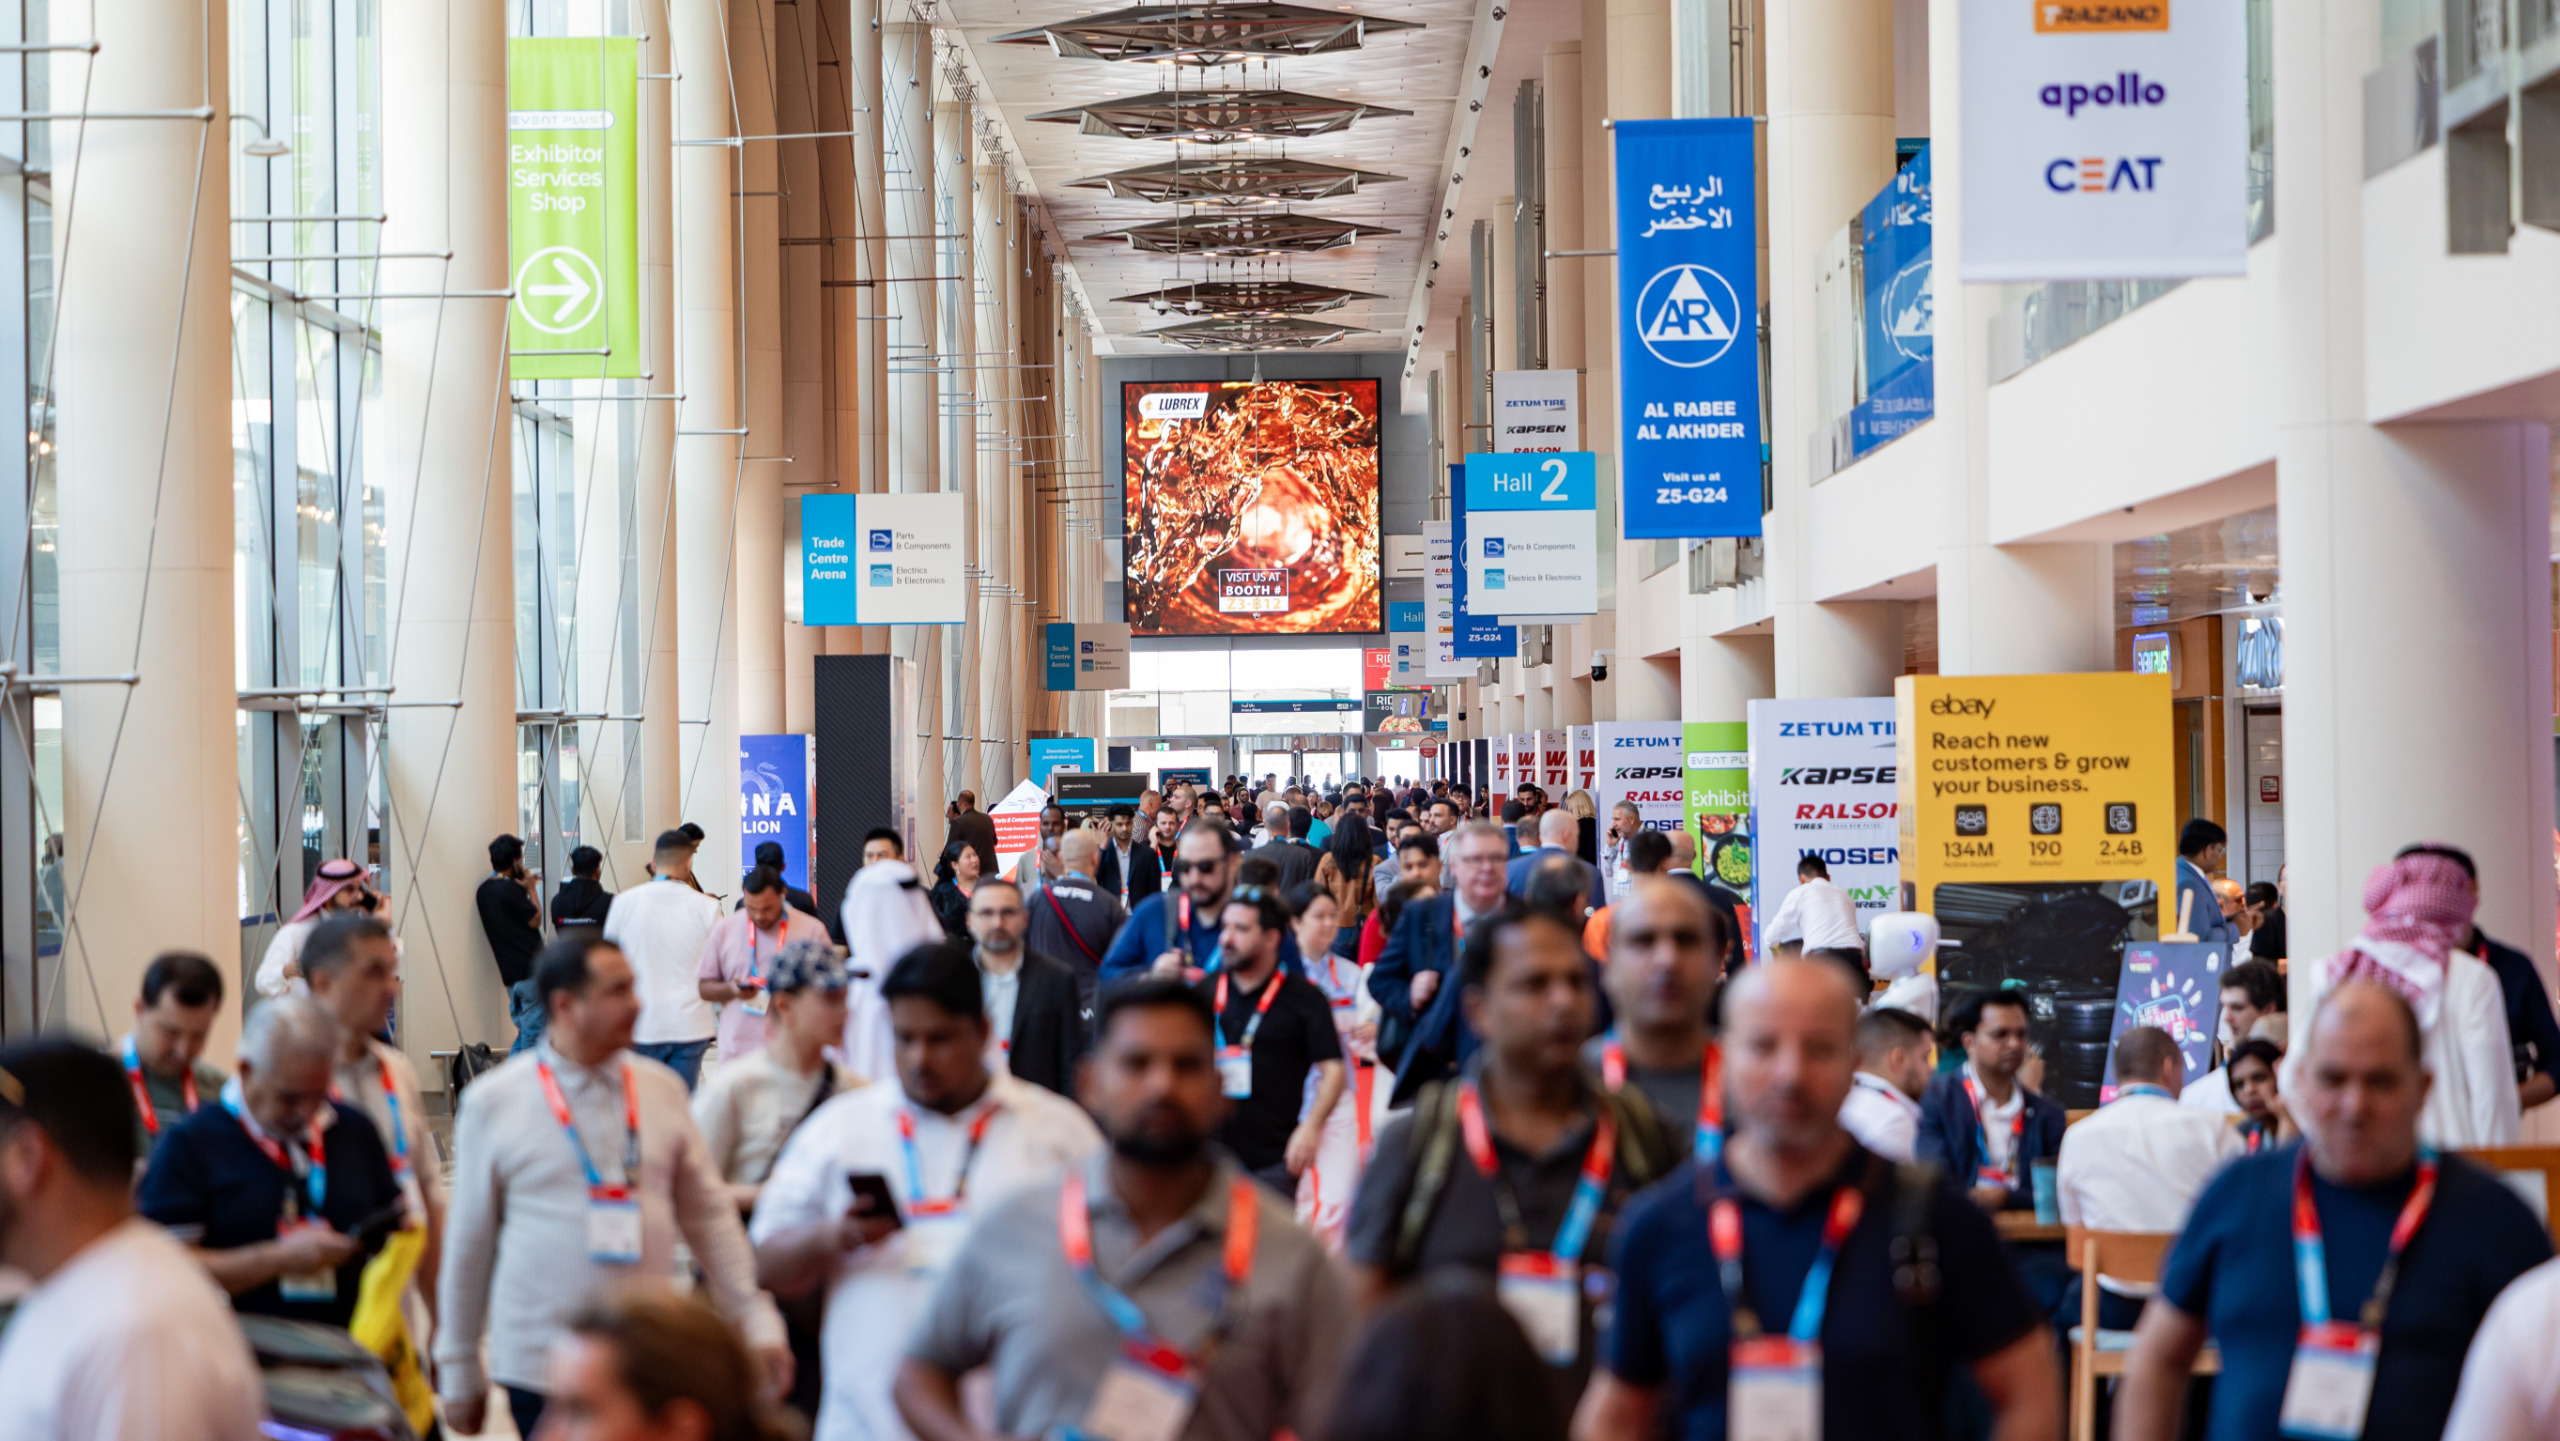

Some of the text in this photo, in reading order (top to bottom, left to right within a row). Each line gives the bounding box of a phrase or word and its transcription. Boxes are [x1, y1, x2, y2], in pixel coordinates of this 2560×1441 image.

[2042, 5, 2159, 25] TRAZANO
[2039, 72, 2165, 117] apollo
[511, 144, 604, 162] Exhibitor
[514, 168, 602, 187] Services
[2045, 158, 2162, 192] CEAT
[1649, 175, 1723, 210] الربيع
[531, 192, 586, 215] Shop
[1658, 298, 1713, 336] AR
[1159, 398, 1200, 410] LUBREX
[1644, 400, 1736, 418] AL RABEE
[1637, 422, 1745, 440] AL AKHDER
[1493, 458, 1568, 502] Hall 2
[1663, 471, 1721, 482] Visit us at
[1656, 487, 1728, 504] Z5-G24
[812, 537, 844, 548] Trade
[896, 532, 915, 540] Parts
[904, 542, 951, 551] Components
[1507, 543, 1524, 551] Parts
[1533, 543, 1576, 551] Components
[809, 553, 848, 564] Centre
[811, 569, 846, 580] Arena
[1226, 572, 1281, 582] VISIT US AT
[1508, 574, 1536, 582] Electrics
[1226, 585, 1281, 596] BOOTH #
[1227, 598, 1281, 610] Z3-B12
[1404, 611, 1424, 622] Hall
[1468, 634, 1501, 642] Z5-G24
[1930, 693, 1995, 719] ebay
[1779, 722, 1863, 736] ZETUM
[1614, 737, 1669, 747] ZETUM
[1932, 732, 2049, 749] Reach new
[1932, 753, 2130, 773] customers & grow
[1932, 776, 2089, 797] your business.
[1943, 840, 2142, 857] 134M 190 2.4B
[2138, 1005, 2159, 1018] LIFE
